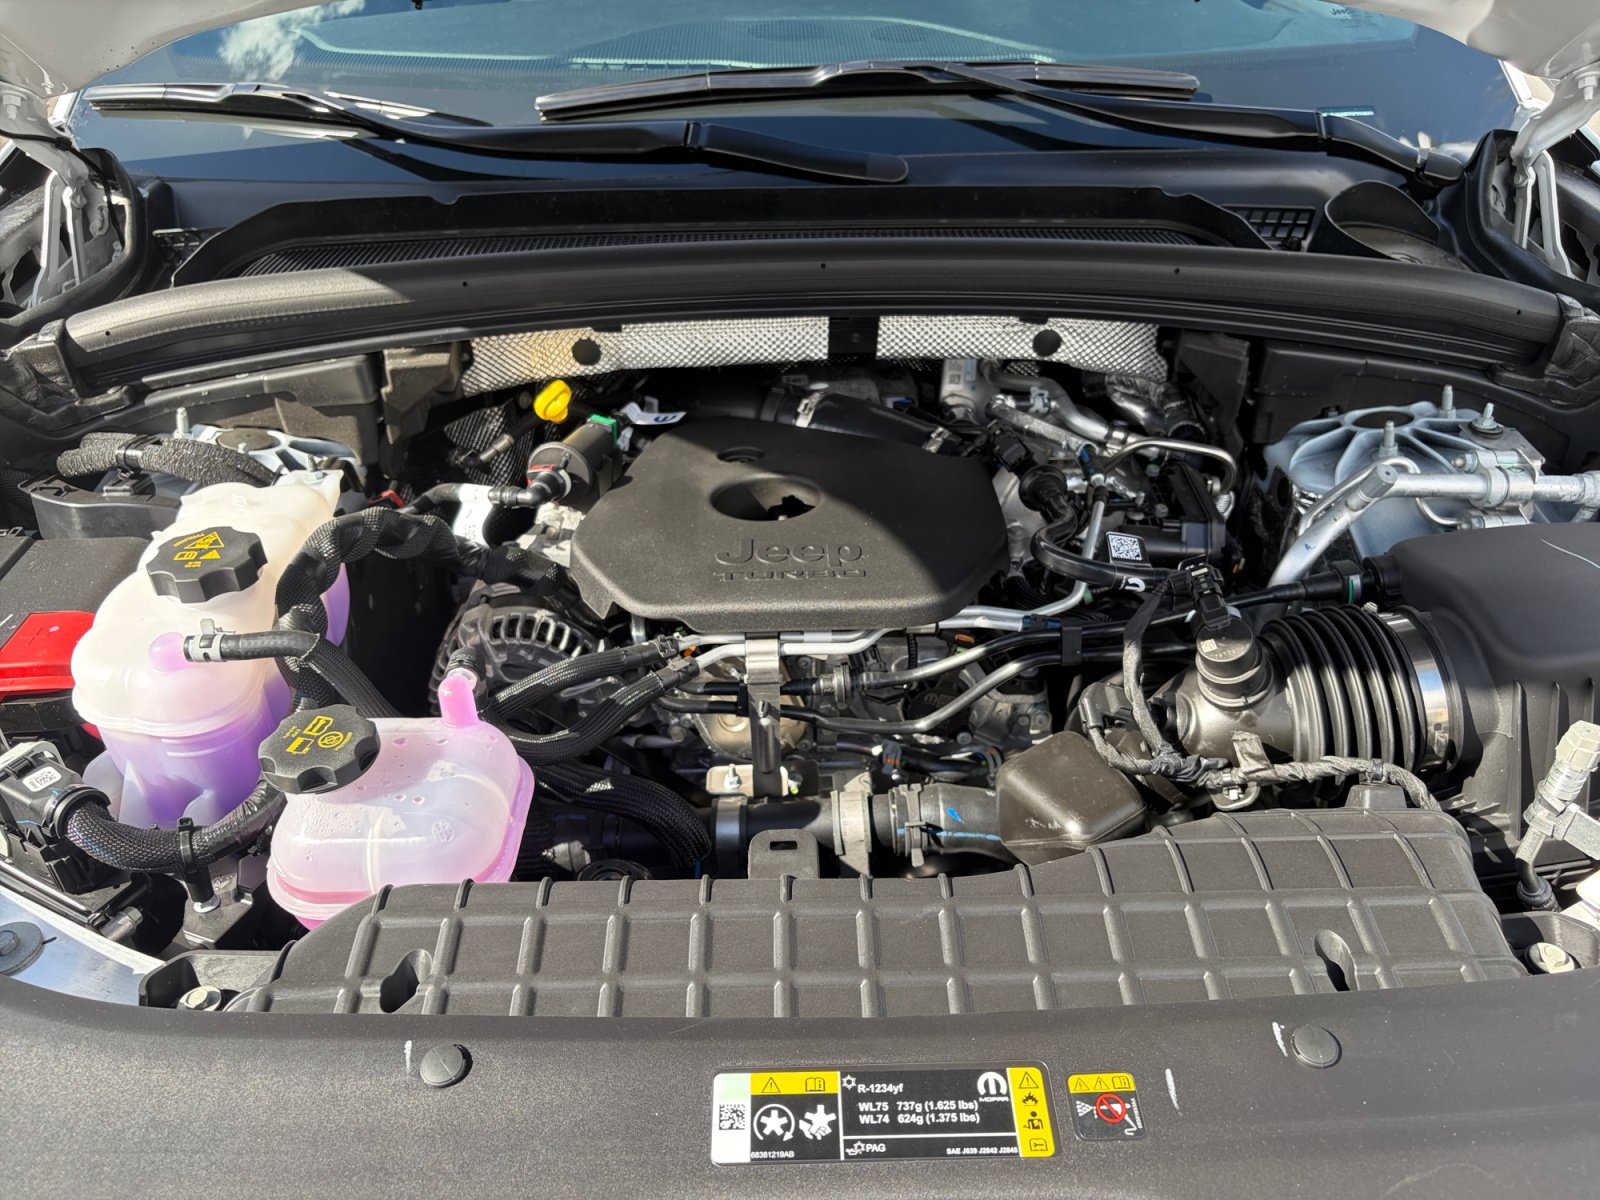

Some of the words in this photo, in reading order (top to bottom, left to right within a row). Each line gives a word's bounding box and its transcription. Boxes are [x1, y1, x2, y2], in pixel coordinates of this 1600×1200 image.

[714, 539, 863, 568] Jeep
[713, 570, 867, 581] TURBO
[857, 1083, 904, 1095] R-1234yf
[858, 1102, 889, 1112] WL75
[896, 1101, 923, 1113] 737g
[924, 1100, 957, 1113] (1.625
[958, 1100, 979, 1111] lbs)
[859, 1114, 890, 1125] WL74
[897, 1113, 924, 1125] 624g
[925, 1112, 958, 1125] (1.375
[959, 1112, 981, 1124] lbs)
[865, 1143, 886, 1153] PAG
[946, 1147, 962, 1155] SAE
